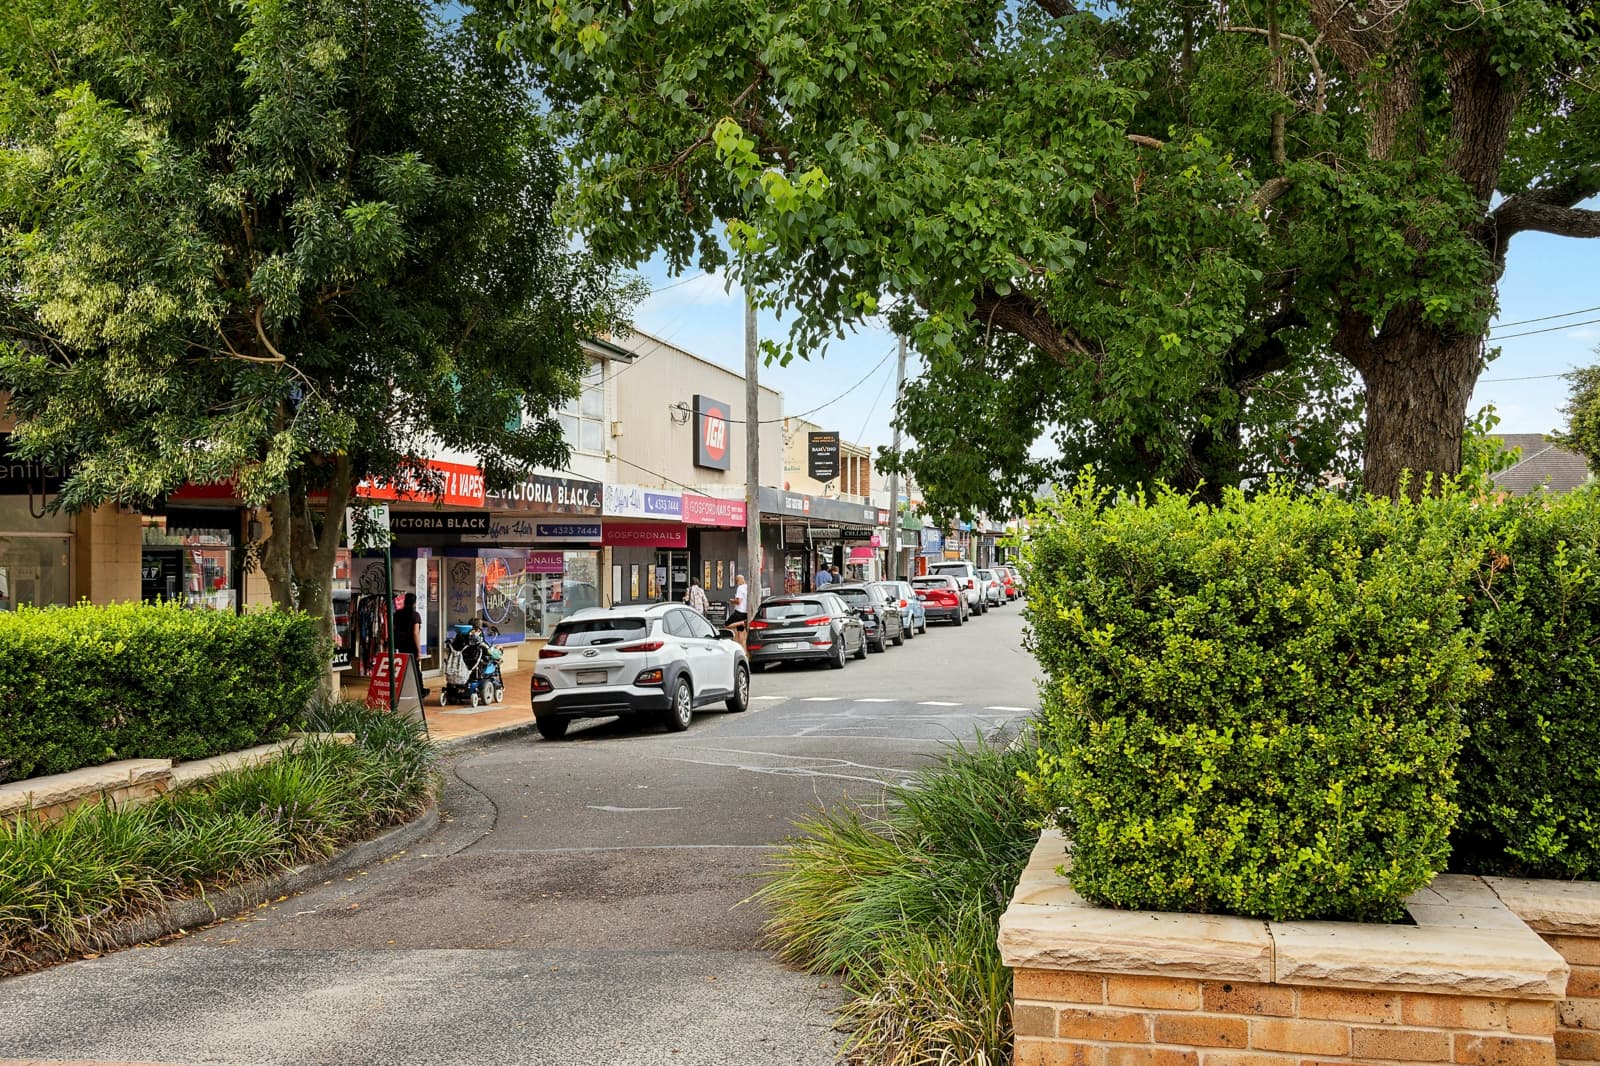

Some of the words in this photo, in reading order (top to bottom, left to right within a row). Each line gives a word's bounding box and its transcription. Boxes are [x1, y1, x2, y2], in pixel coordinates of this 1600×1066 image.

[706, 417, 725, 449] IGA
[450, 472, 457, 496] &
[459, 473, 484, 499] VAPES
[557, 485, 590, 507] BLACK
[372, 508, 385, 520] 1P
[389, 517, 443, 529] VICTORIA
[447, 517, 486, 529] BLACK
[552, 526, 574, 535] 4323
[576, 526, 599, 535] 7444
[607, 531, 681, 541] GOSFORDNAILS
[486, 593, 507, 609] HAIR
[376, 656, 403, 679] EG
